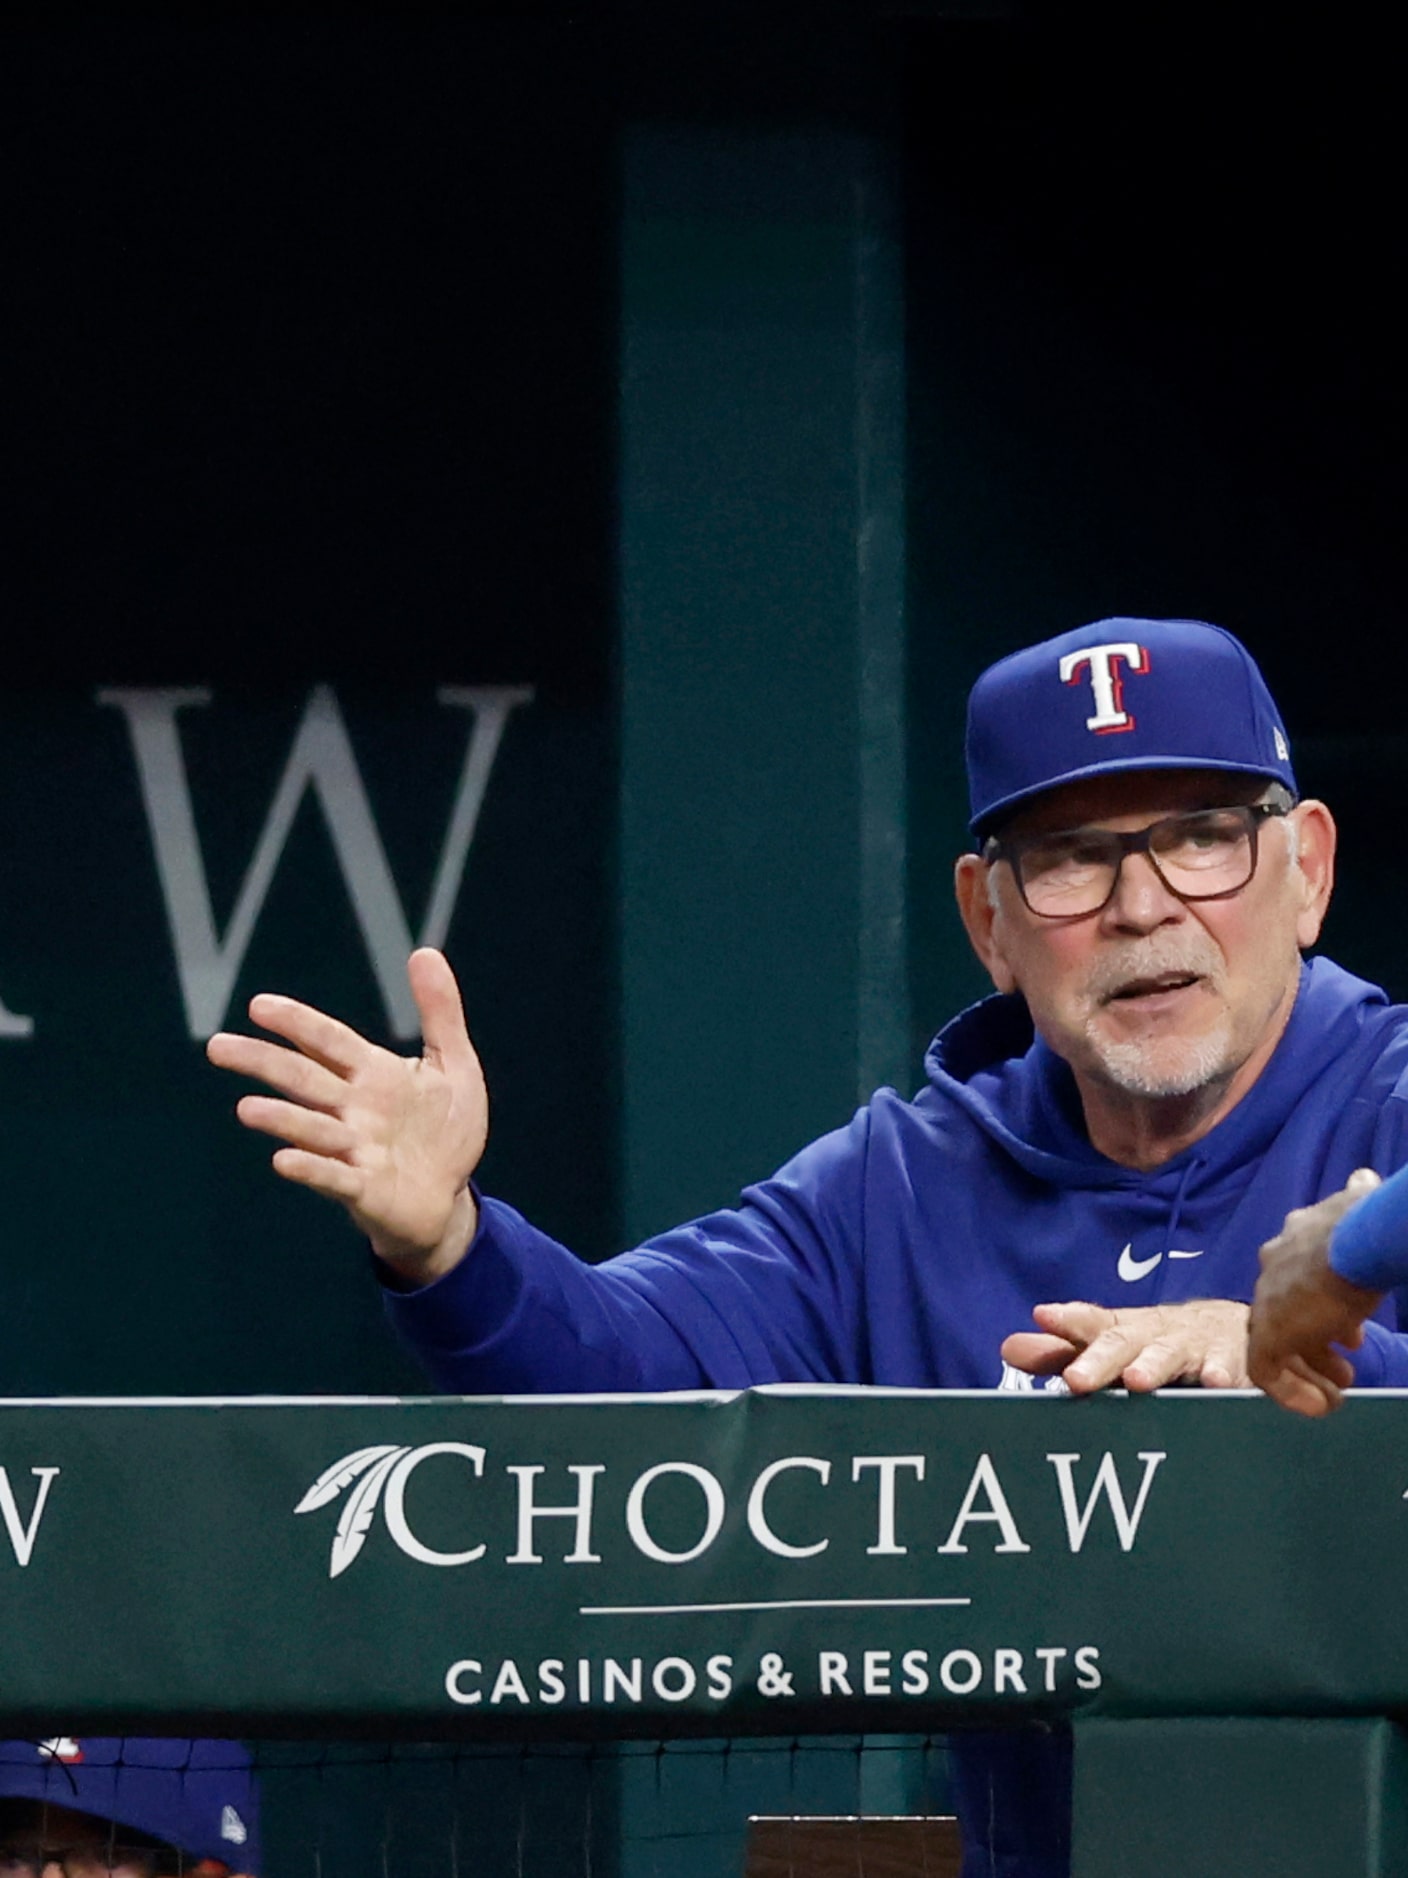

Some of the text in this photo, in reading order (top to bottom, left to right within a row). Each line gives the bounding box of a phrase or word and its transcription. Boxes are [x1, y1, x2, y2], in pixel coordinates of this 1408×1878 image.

[1058, 641, 1152, 736] T
[0, 683, 538, 1042] W
[383, 1440, 1168, 1567] CHOCTAW
[444, 1645, 1102, 1705] CASINOS & RESORTS
